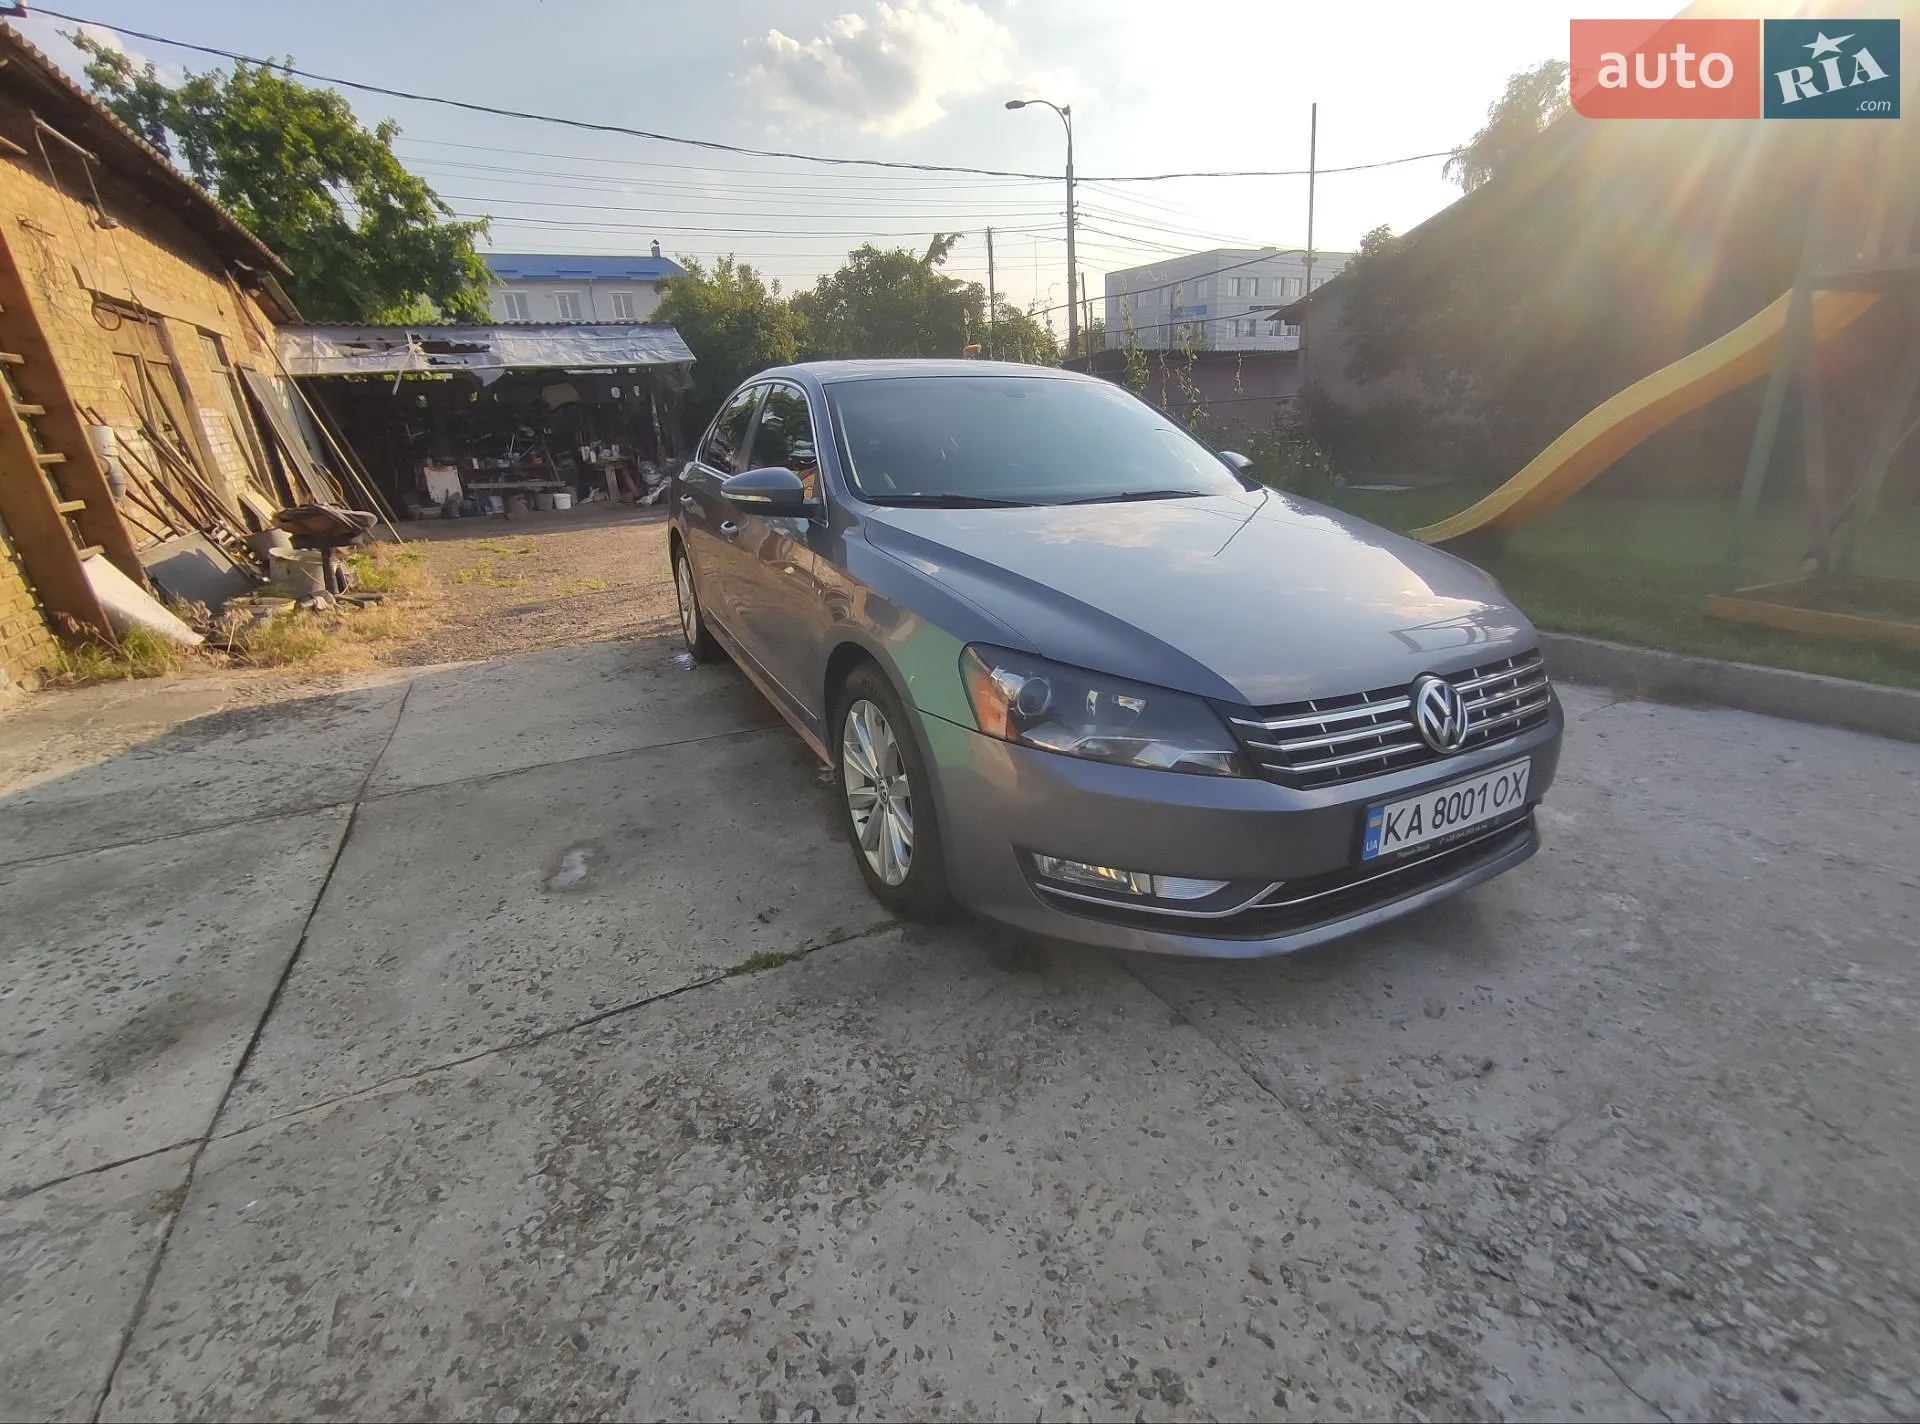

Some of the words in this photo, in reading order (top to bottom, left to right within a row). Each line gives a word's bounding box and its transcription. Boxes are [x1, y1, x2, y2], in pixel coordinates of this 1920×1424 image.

[1383, 803, 1423, 846] KA
[1431, 782, 1488, 830] 8001
[1493, 767, 1527, 807] OX
[1365, 839, 1378, 852] UA
